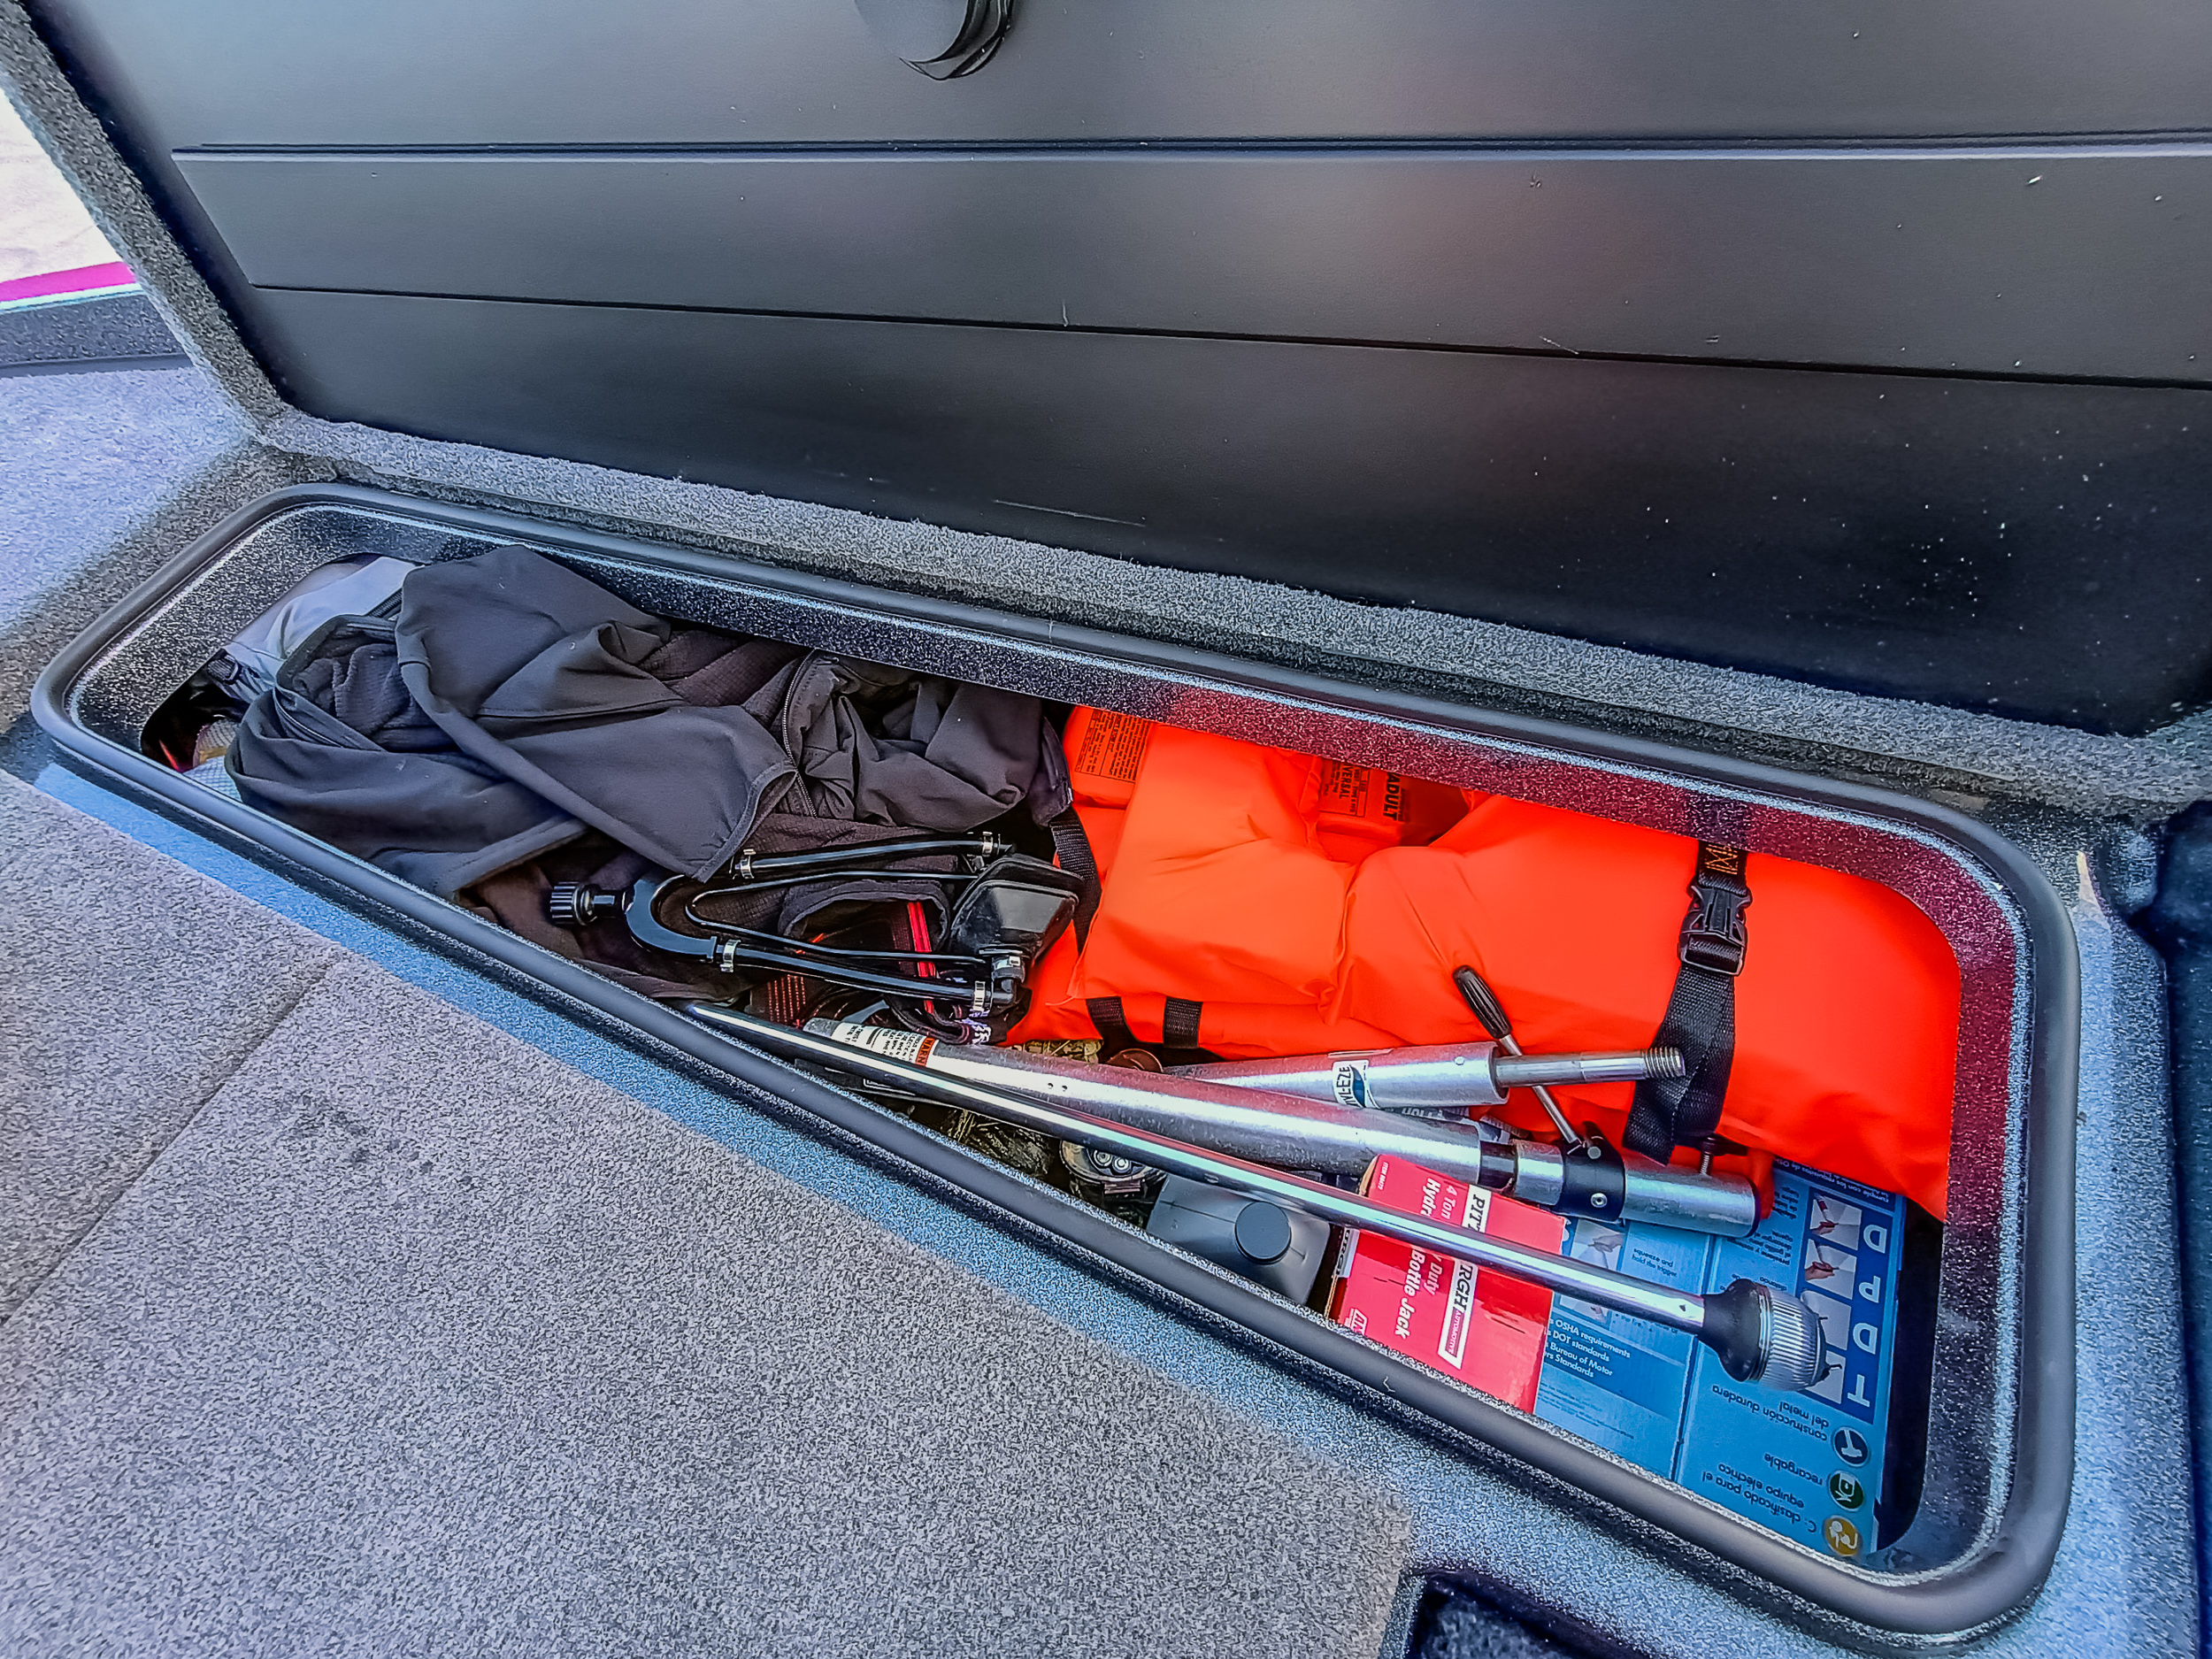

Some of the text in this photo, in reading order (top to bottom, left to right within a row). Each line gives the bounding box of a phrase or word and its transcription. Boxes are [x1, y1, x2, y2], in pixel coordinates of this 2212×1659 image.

[1339, 764, 1353, 799] IVERSAL
[1383, 772, 1402, 821] ADULT
[918, 1039, 932, 1064] WARN
[1337, 1066, 1362, 1108] IVL-EZE
[1420, 1178, 1441, 1217] Hydra
[1440, 1185, 1458, 1219] 4 Ton
[1633, 1248, 1660, 1262] squeeze
[1863, 1225, 1887, 1254] D
[1632, 1254, 1646, 1264] hold
[1395, 1249, 1425, 1340] Bottle Jack
[1423, 1265, 1443, 1295] Duty
[1858, 1275, 1881, 1303] P
[1448, 1310, 1462, 1354] AUTOMOTIVE
[1553, 1331, 1571, 1344] DOT
[1572, 1340, 1609, 1362] standards
[1555, 1319, 1579, 1336] OSHA
[1580, 1332, 1631, 1358] requirements
[1853, 1322, 1878, 1355] D
[1550, 1342, 1578, 1361] Bureau
[1588, 1359, 1613, 1376] Motor
[1555, 1355, 1594, 1378] Standards
[1847, 1374, 1870, 1408] T
[1712, 1386, 1828, 1441] construcción duradera
[1779, 1402, 1830, 1429] del metal
[1702, 1471, 1713, 1482] el
[1718, 1463, 1805, 1509] equipo eléctrico
[1764, 1453, 1823, 1486] recargable
[1716, 1478, 1741, 1495] para
[1744, 1490, 1801, 1525] clasificado
